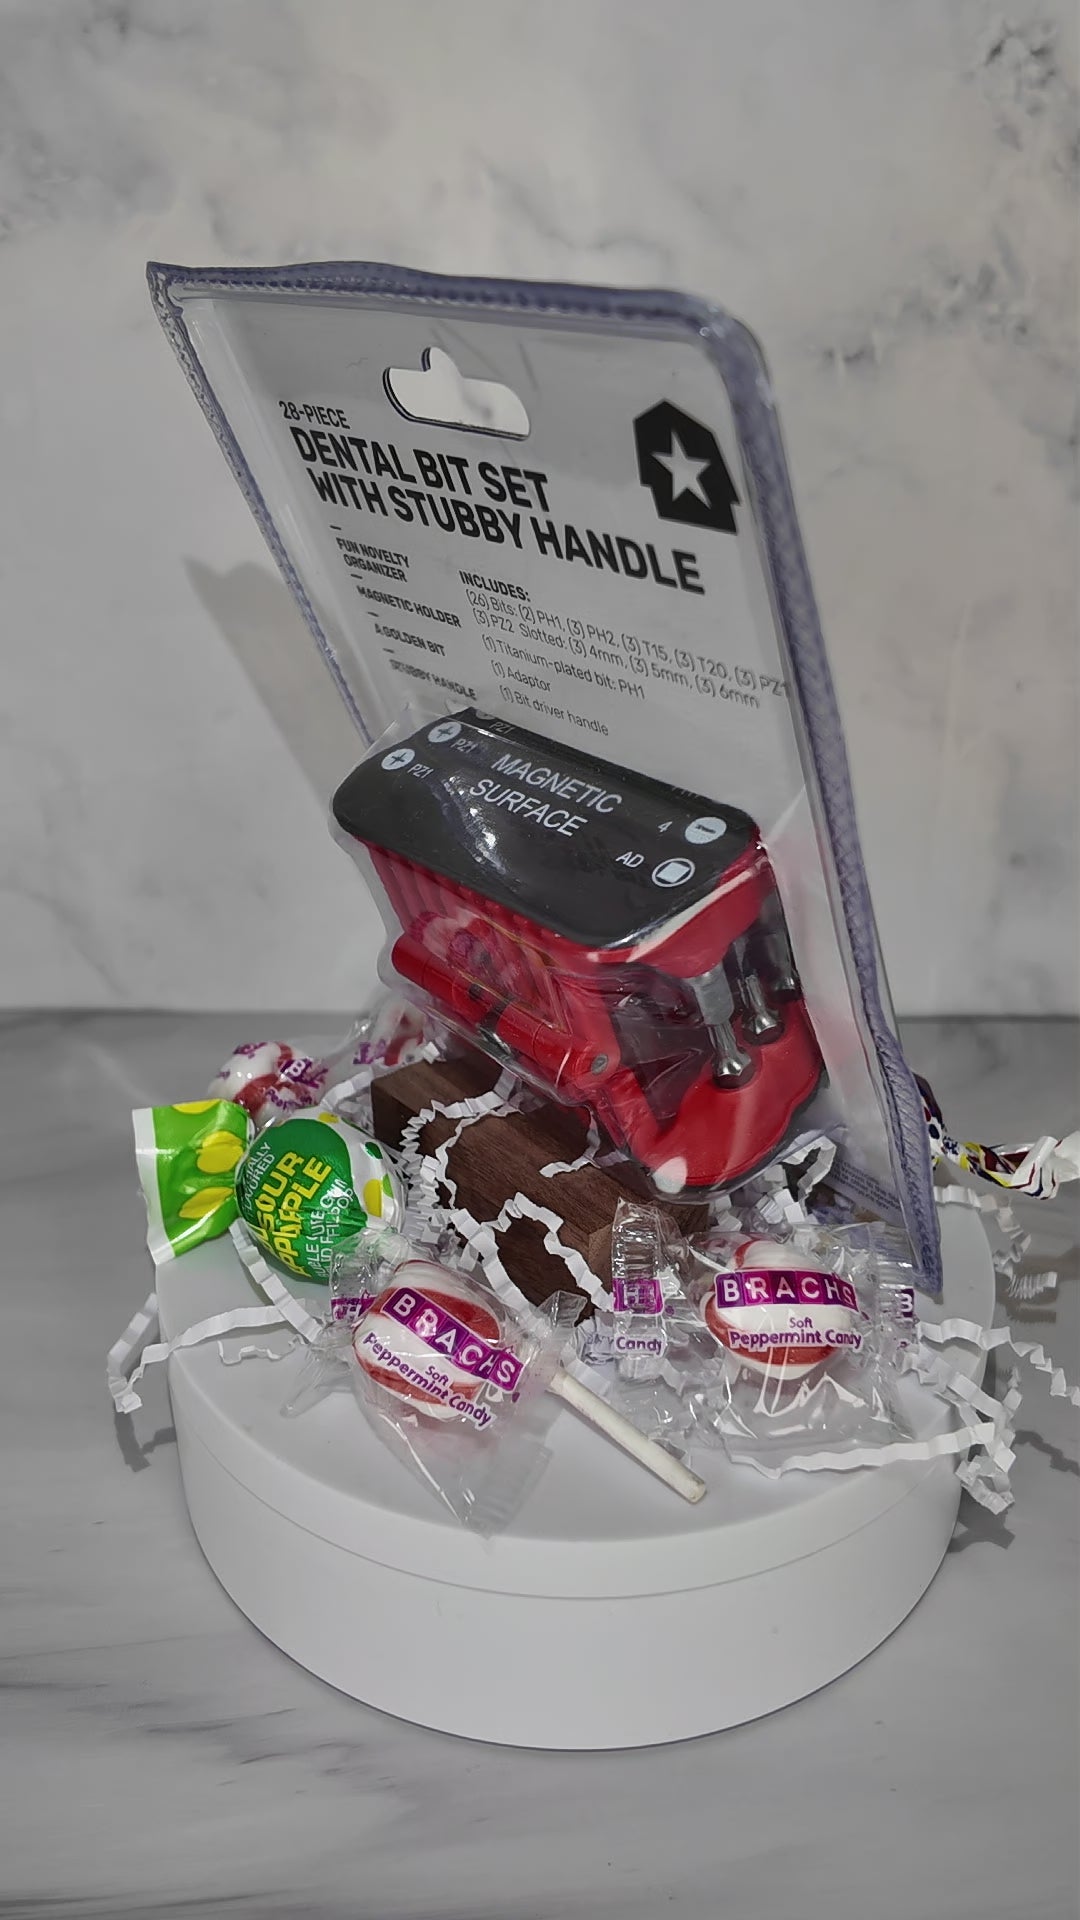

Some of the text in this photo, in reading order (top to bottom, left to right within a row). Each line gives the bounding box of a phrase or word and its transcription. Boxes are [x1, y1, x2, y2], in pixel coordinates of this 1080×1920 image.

[278, 400, 350, 429] 28-PIECE
[289, 426, 549, 512] DENTAL BIT SET
[306, 467, 705, 595] WITH STUBBY HANDLE
[336, 537, 410, 568] FUN NOVELTY
[343, 554, 408, 583] ORGANIZER
[459, 570, 531, 602] INCLUDES:
[356, 585, 462, 628] MAGNETIC HOLDER
[382, 626, 426, 648] GOLDEN
[426, 638, 445, 656] BIT
[465, 588, 490, 610] (26)
[490, 596, 518, 617] Bits:
[518, 603, 535, 625] (2)
[566, 617, 585, 639] (3)
[621, 633, 641, 656] (3)
[674, 648, 695, 672] (3)
[734, 666, 756, 691] (3)
[472, 607, 490, 628] (3)
[490, 614, 515, 633] PZ2
[518, 622, 568, 649] Slotted:
[568, 636, 587, 658] (3)
[629, 655, 648, 677] (3)
[695, 674, 716, 698] (3)
[719, 684, 760, 709] 6mm
[482, 634, 646, 700] (1) Titanium-plated bit: PH1
[491, 659, 551, 692] (1) Adaptor
[499, 685, 610, 736] (1) Bit driver handle
[407, 763, 433, 779] PZ1
[490, 753, 622, 813] MAGNETIC
[469, 778, 588, 837] SURFACE
[657, 820, 673, 833] 4
[615, 851, 645, 868] AD
[255, 1151, 305, 1231] SOUR
[789, 1317, 813, 1329] Soft
[616, 1336, 662, 1356] Candy
[730, 1329, 821, 1350] Peppermint
[363, 1332, 492, 1427] Peppermint Candy
[425, 1365, 450, 1386] Soft
